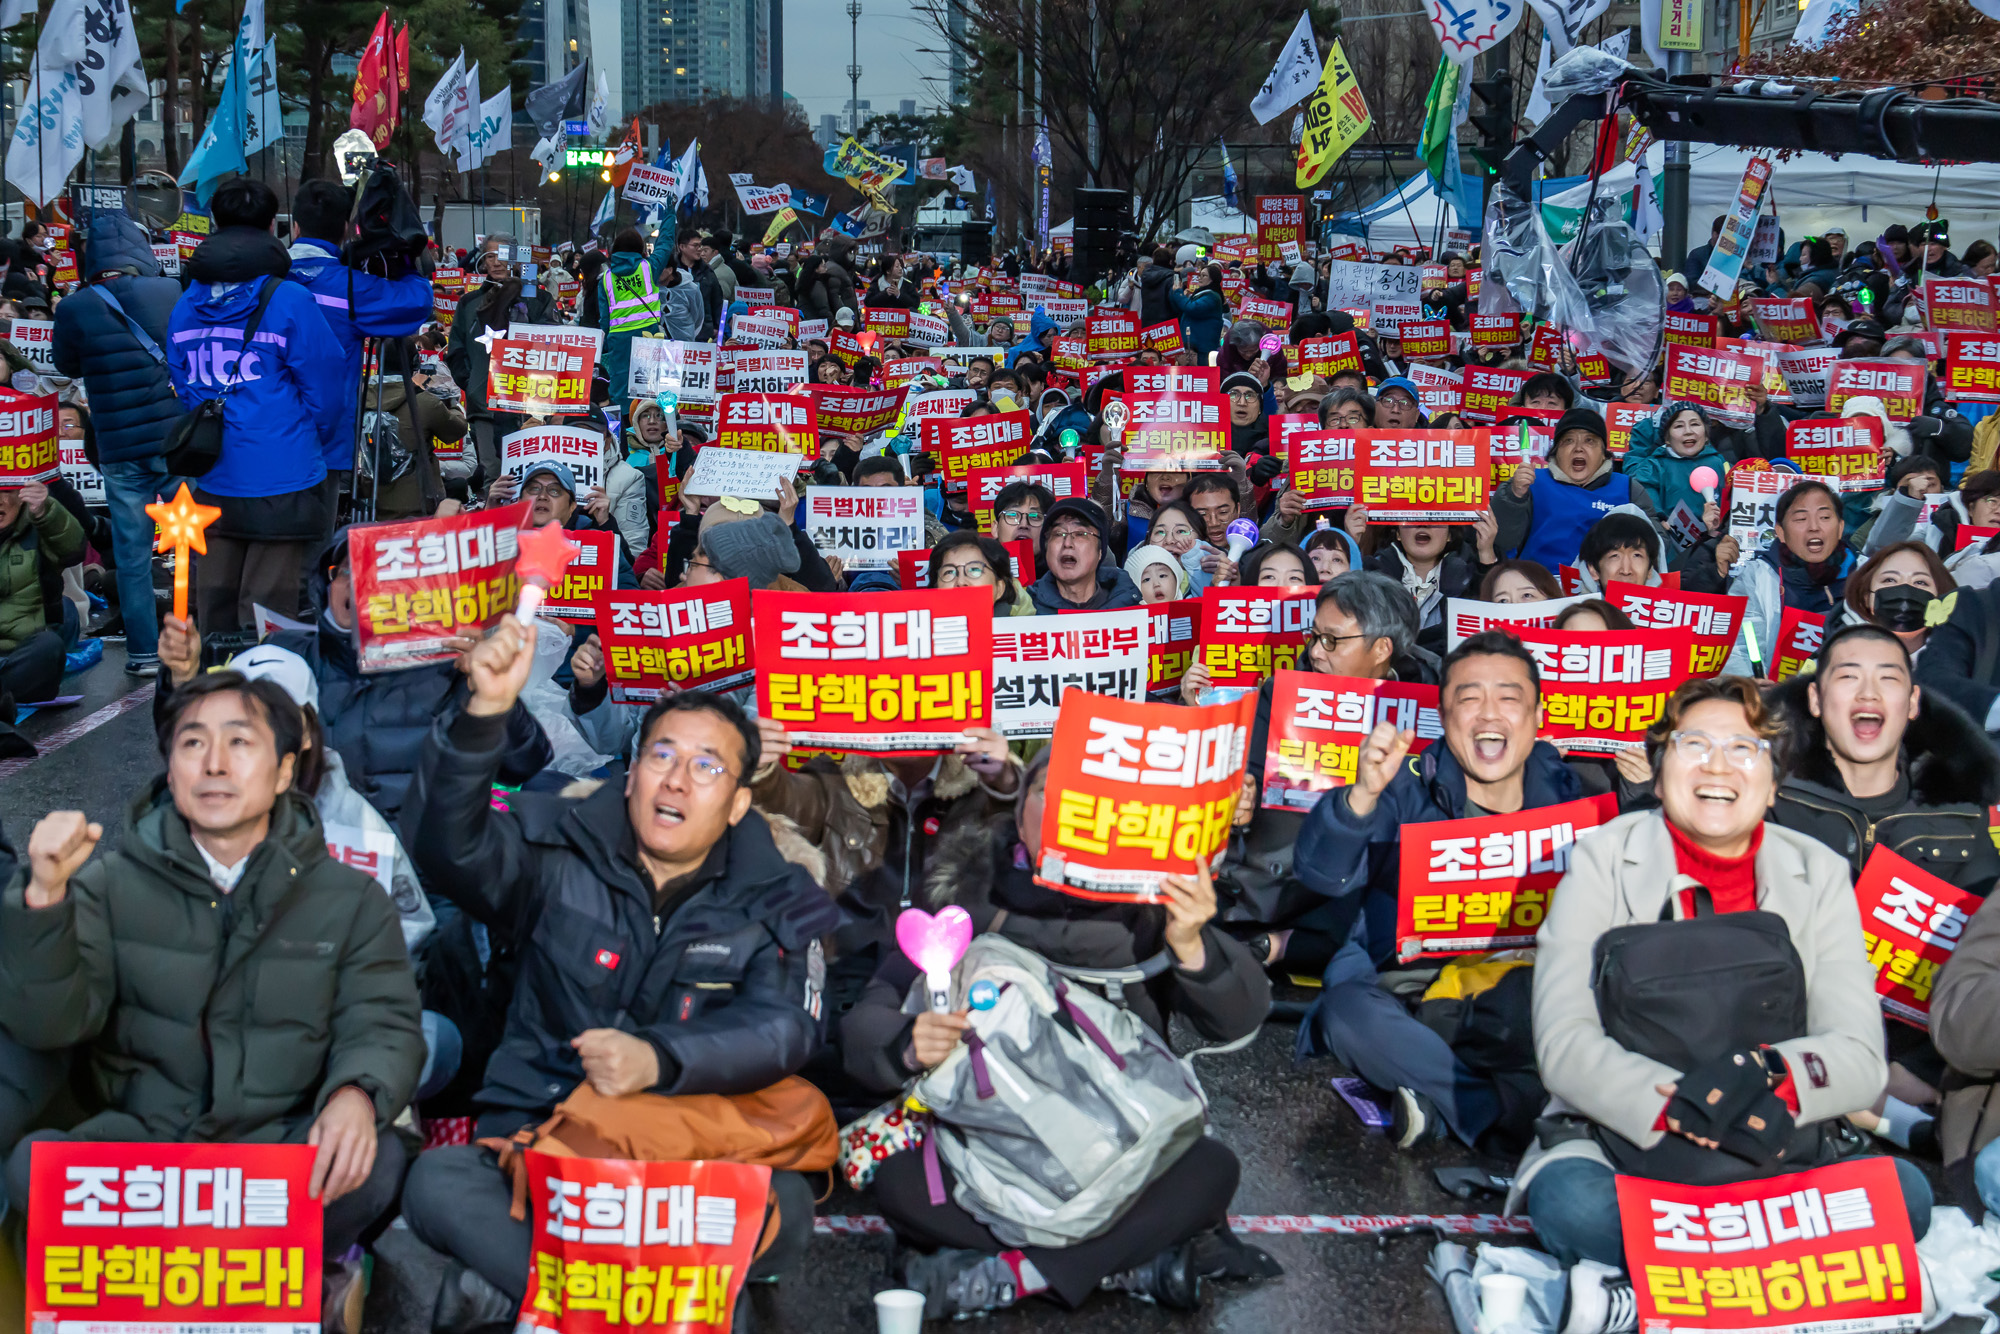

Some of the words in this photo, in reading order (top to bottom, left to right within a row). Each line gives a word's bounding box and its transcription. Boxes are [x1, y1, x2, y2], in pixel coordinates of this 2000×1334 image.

[632, 168, 675, 187] 특별재판부
[1262, 199, 1282, 211] 내란당은
[1284, 199, 1298, 211] 국민을
[1260, 212, 1270, 225] 절대
[1272, 213, 1282, 224] 이길
[1284, 213, 1290, 224] 수
[1291, 212, 1302, 224] 없다
[1266, 227, 1297, 242] 내란당이
[1216, 245, 1239, 255] 조희대를
[1022, 275, 1048, 284] 특별재판부
[1378, 269, 1419, 294] 종신형
[737, 290, 772, 300] 특별재판부
[991, 296, 1019, 306] 조희대를
[1935, 287, 1989, 305] 조희대를
[869, 310, 907, 322] 조희대를
[1009, 312, 1032, 322] 조희대
[1047, 302, 1086, 312] 특별재판부
[1247, 301, 1287, 318] 조희대를
[1375, 304, 1420, 315] 특별재판부
[1756, 304, 1807, 320] 조희대를
[737, 321, 786, 339] 특별재판부
[800, 324, 825, 335] 재판부
[866, 323, 908, 337] 탄핵하라!
[910, 317, 948, 334] 특별재판부
[1091, 317, 1134, 334] 조희대를
[1474, 317, 1514, 329] 조희대를
[1932, 307, 1995, 331] 탄핵하라!
[15, 326, 53, 342] 특별재
[514, 332, 596, 348] 특별재판부
[908, 330, 947, 347] 설치하라!
[1403, 325, 1443, 338] 조희대를
[1472, 330, 1517, 345] 탄핵하라!
[1058, 340, 1087, 356] 조희
[1088, 337, 1139, 352] 탄핵하라!
[1155, 336, 1181, 353] 하라!
[1303, 340, 1351, 359] 조희대를
[1402, 339, 1447, 353] 탄핵하라!
[1960, 341, 2000, 362] 조희
[187, 342, 262, 387] jtbc
[503, 347, 583, 372] 조희대를
[737, 357, 804, 372] 특별재판부
[1677, 351, 1751, 381] 조희대를
[1780, 356, 1836, 374] 특별재판부
[494, 372, 586, 399] 탄핵하라!
[1133, 374, 1209, 393] 조희대를
[1472, 372, 1525, 392] 조희대
[1838, 368, 1912, 391] 조희대를
[1670, 376, 1751, 408] 탄핵하라!
[727, 401, 808, 426] 조희대를
[820, 395, 898, 413] 조희대를
[1132, 401, 1219, 423] 조희대를
[1831, 394, 1917, 418] 탄라!
[0, 408, 54, 438] 희대를
[816, 409, 897, 432] 탄핵하라!
[720, 431, 816, 456] 탄핵하라!
[950, 420, 1023, 449] 조희대를
[1125, 431, 1225, 454] 탄핵하라!
[1490, 435, 1553, 457] 조희대
[1794, 426, 1871, 449] 조희대를
[0, 437, 58, 470] 핵하라!
[507, 435, 598, 458] 특별재판부
[1300, 438, 1355, 463] 조희
[1370, 438, 1476, 468] 조희대를
[948, 446, 1028, 478] 탄핵하라!
[1790, 452, 1879, 477] 탄핵하라!
[1361, 475, 1483, 504] 탄핵하라!
[812, 496, 918, 518] 특별재판부
[813, 525, 918, 551] 설치하라!
[375, 523, 520, 581] 조희대를
[543, 573, 604, 601] 하라!
[610, 598, 734, 638] 조희대를
[1216, 598, 1317, 634] 조희대
[1621, 598, 1735, 640] 조희대를
[780, 609, 969, 661] 조희대를
[1147, 614, 1192, 647] 대를
[992, 626, 1140, 662] 특별재판부
[610, 634, 745, 682] 탄핵하라!
[1205, 643, 1304, 679] 탄핵하
[1524, 641, 1672, 684] 조희대를
[768, 670, 983, 723] 탄핵하라!
[994, 667, 1138, 710] 설치하라!
[1540, 691, 1674, 733] 핵하라
[1080, 716, 1247, 788] 조희대를
[1057, 788, 1243, 862] 탄핵하라
[1428, 821, 1596, 883] 조희대
[1412, 889, 1556, 932] 탄핵하
[1872, 875, 1970, 952] 조희
[61, 1165, 290, 1228] 조희대를
[546, 1176, 737, 1247] 조희대를
[1650, 1187, 1876, 1254] 조희대를
[44, 1245, 305, 1309] 탄핵하라!
[533, 1250, 734, 1327] 탄핵하라!
[1645, 1242, 1907, 1316] 탄핵하라!
